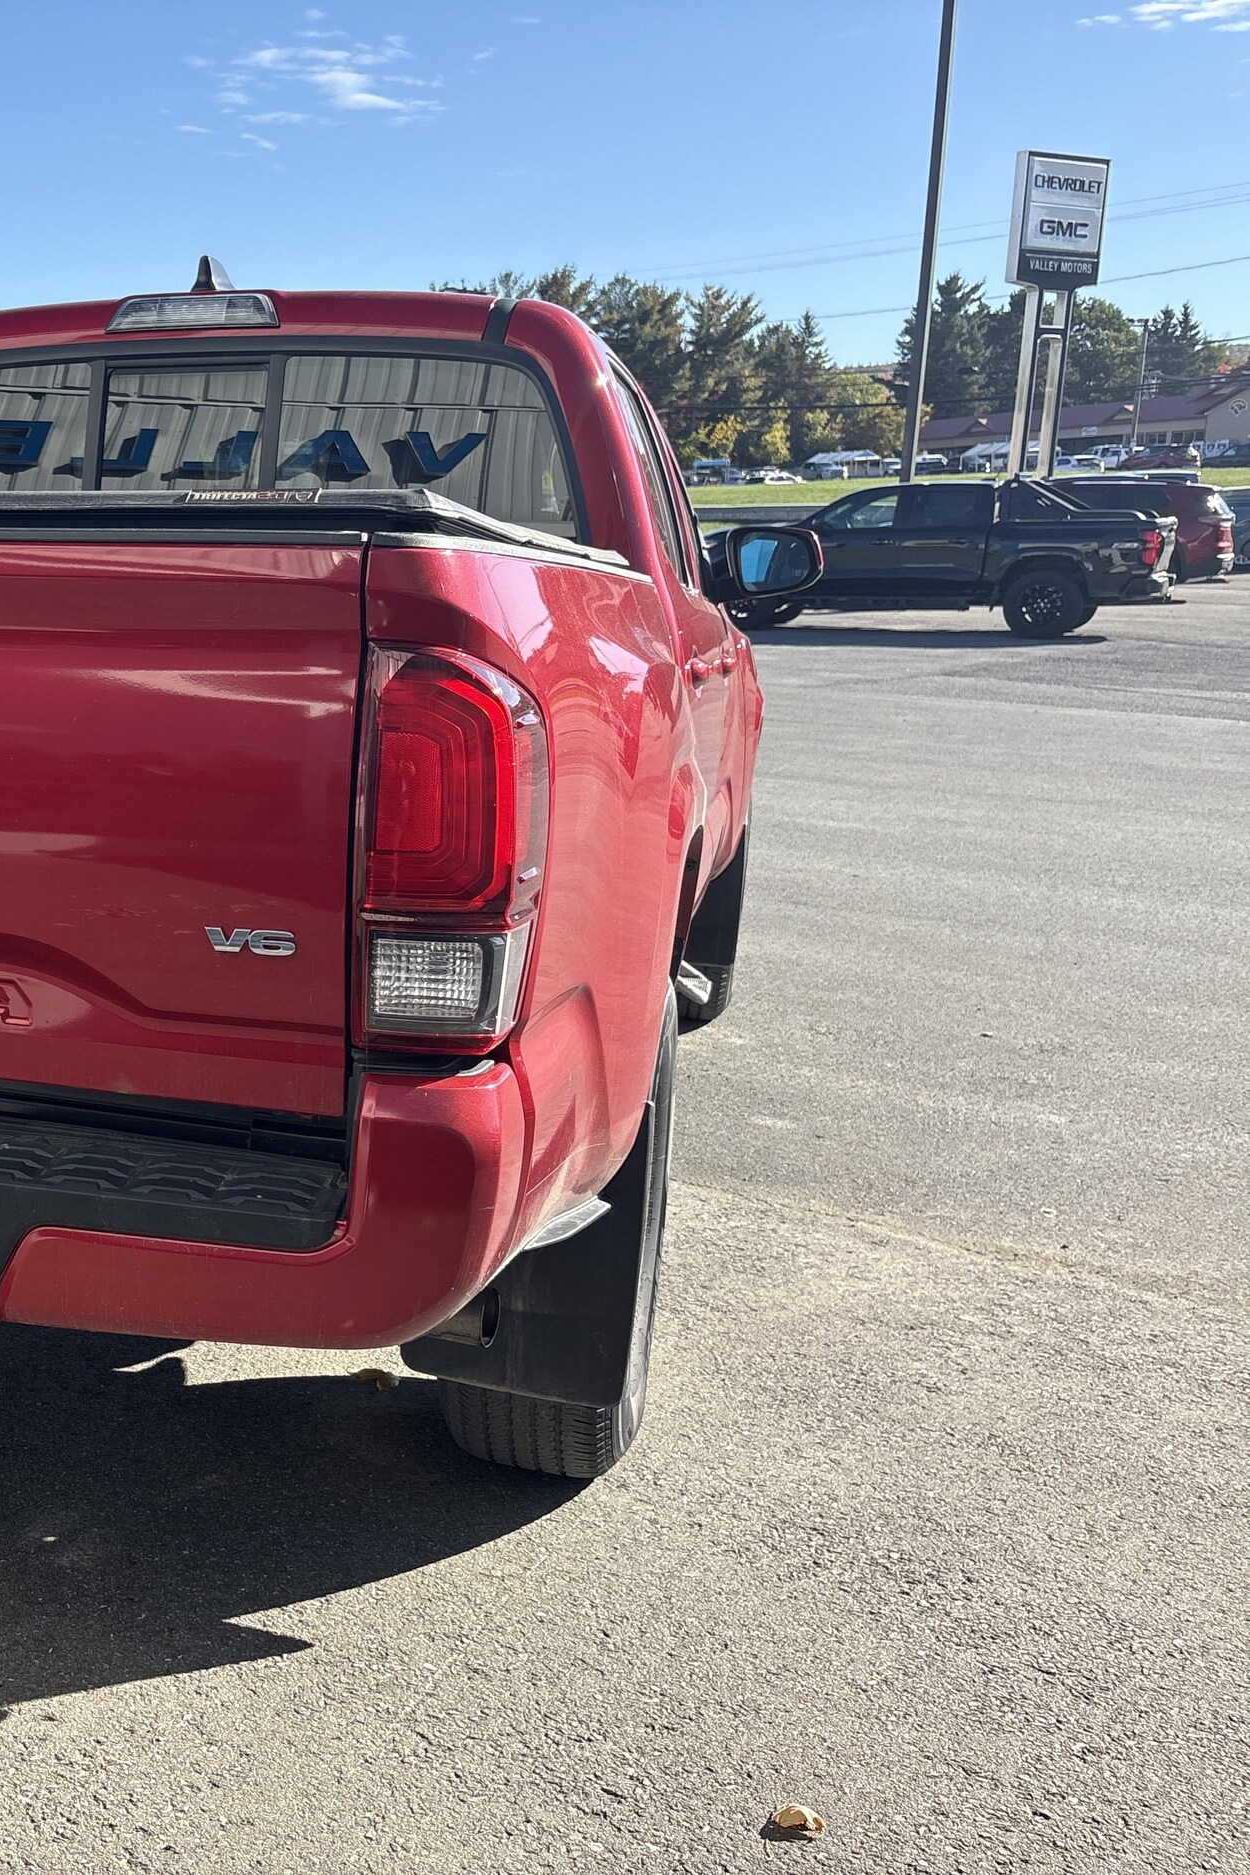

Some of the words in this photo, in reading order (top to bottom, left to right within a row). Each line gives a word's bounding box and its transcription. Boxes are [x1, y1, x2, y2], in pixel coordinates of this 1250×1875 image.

[1034, 173, 1103, 194] CHEVROLET
[1039, 219, 1089, 238] GMC
[1030, 259, 1058, 272] VALLEY
[1060, 262, 1093, 273] MOTORS
[192, 491, 256, 500] TRIFECTA
[203, 925, 296, 956] V6
